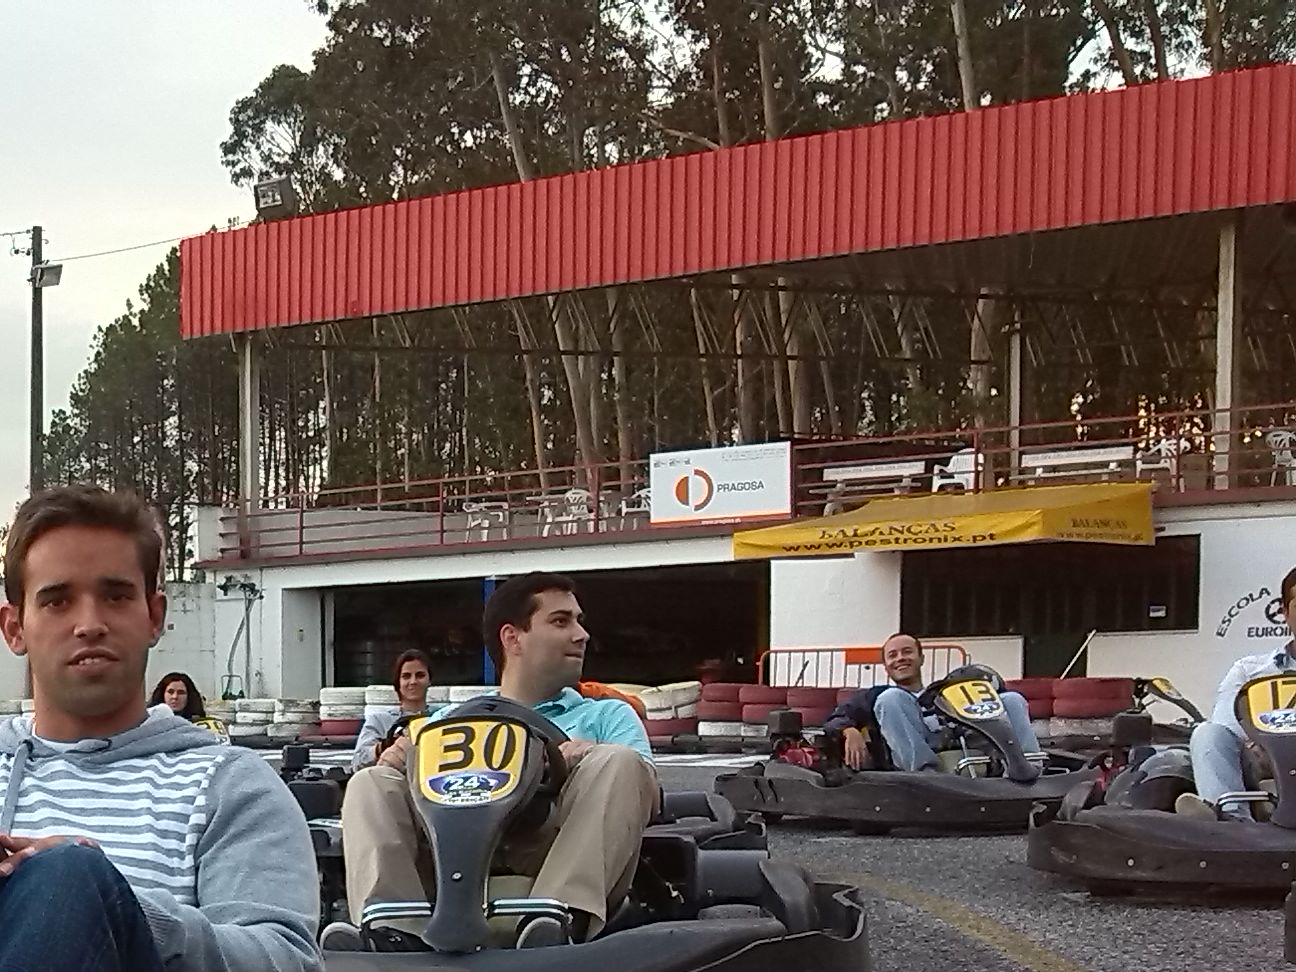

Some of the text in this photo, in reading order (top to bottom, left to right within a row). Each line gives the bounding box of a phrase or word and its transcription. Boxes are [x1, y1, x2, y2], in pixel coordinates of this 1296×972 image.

[717, 480, 765, 493] PRAGOSA
[782, 532, 997, 553] www.pestronix.pt
[1216, 587, 1271, 638] ESCOLA
[1247, 626, 1292, 638] EUROI
[959, 682, 997, 705] 13
[438, 721, 517, 773] 30
[447, 776, 481, 791] 24
